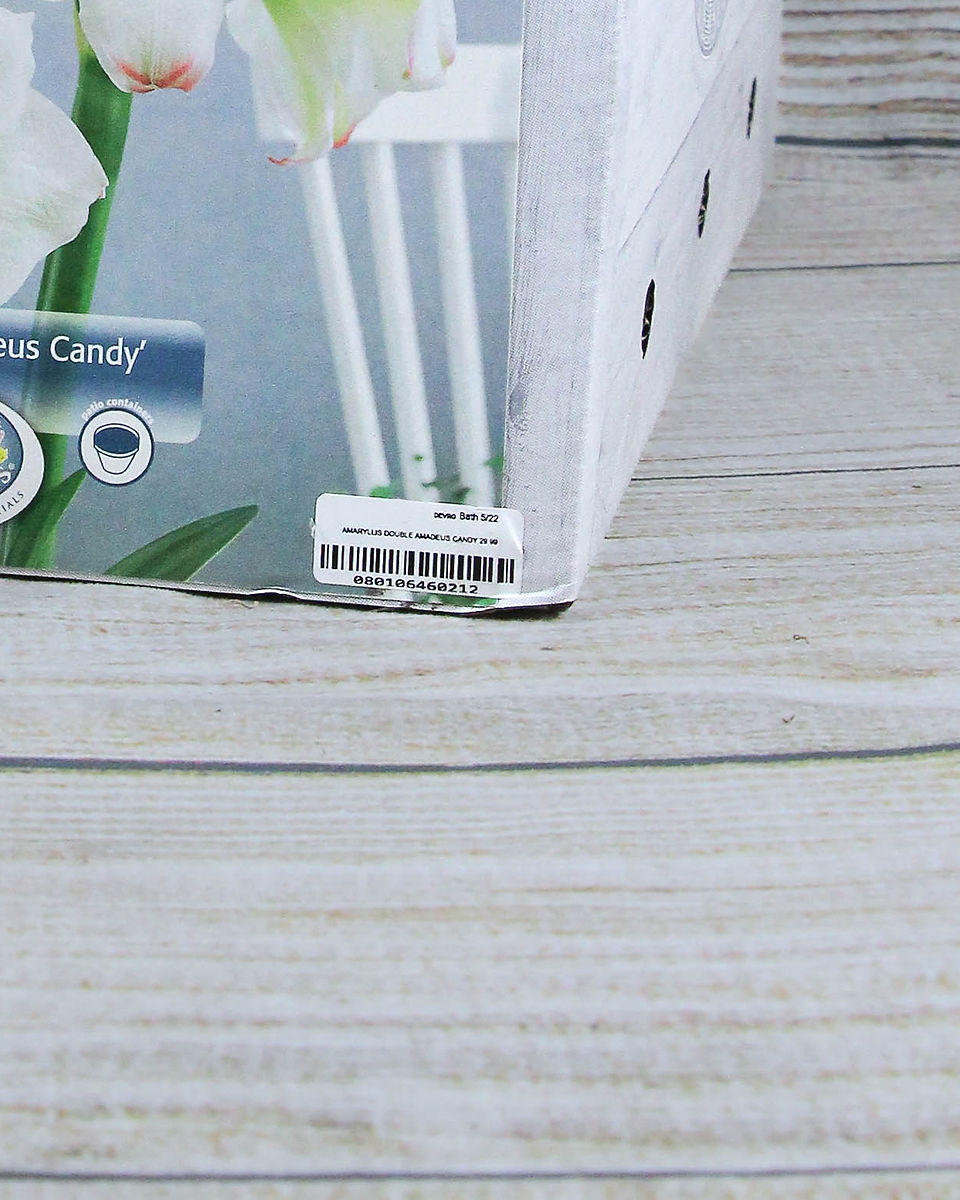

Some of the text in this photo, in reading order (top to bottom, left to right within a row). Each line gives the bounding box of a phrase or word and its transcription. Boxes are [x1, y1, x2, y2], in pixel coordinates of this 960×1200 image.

[81, 398, 154, 425] patio containers
[480, 513, 499, 523] 5/22
[342, 526, 382, 536] AMARYLLIS
[383, 529, 414, 539] DOUBLE
[414, 532, 451, 542] AMADEUS
[452, 535, 478, 544] CANDY
[353, 575, 478, 594] 080106460212
